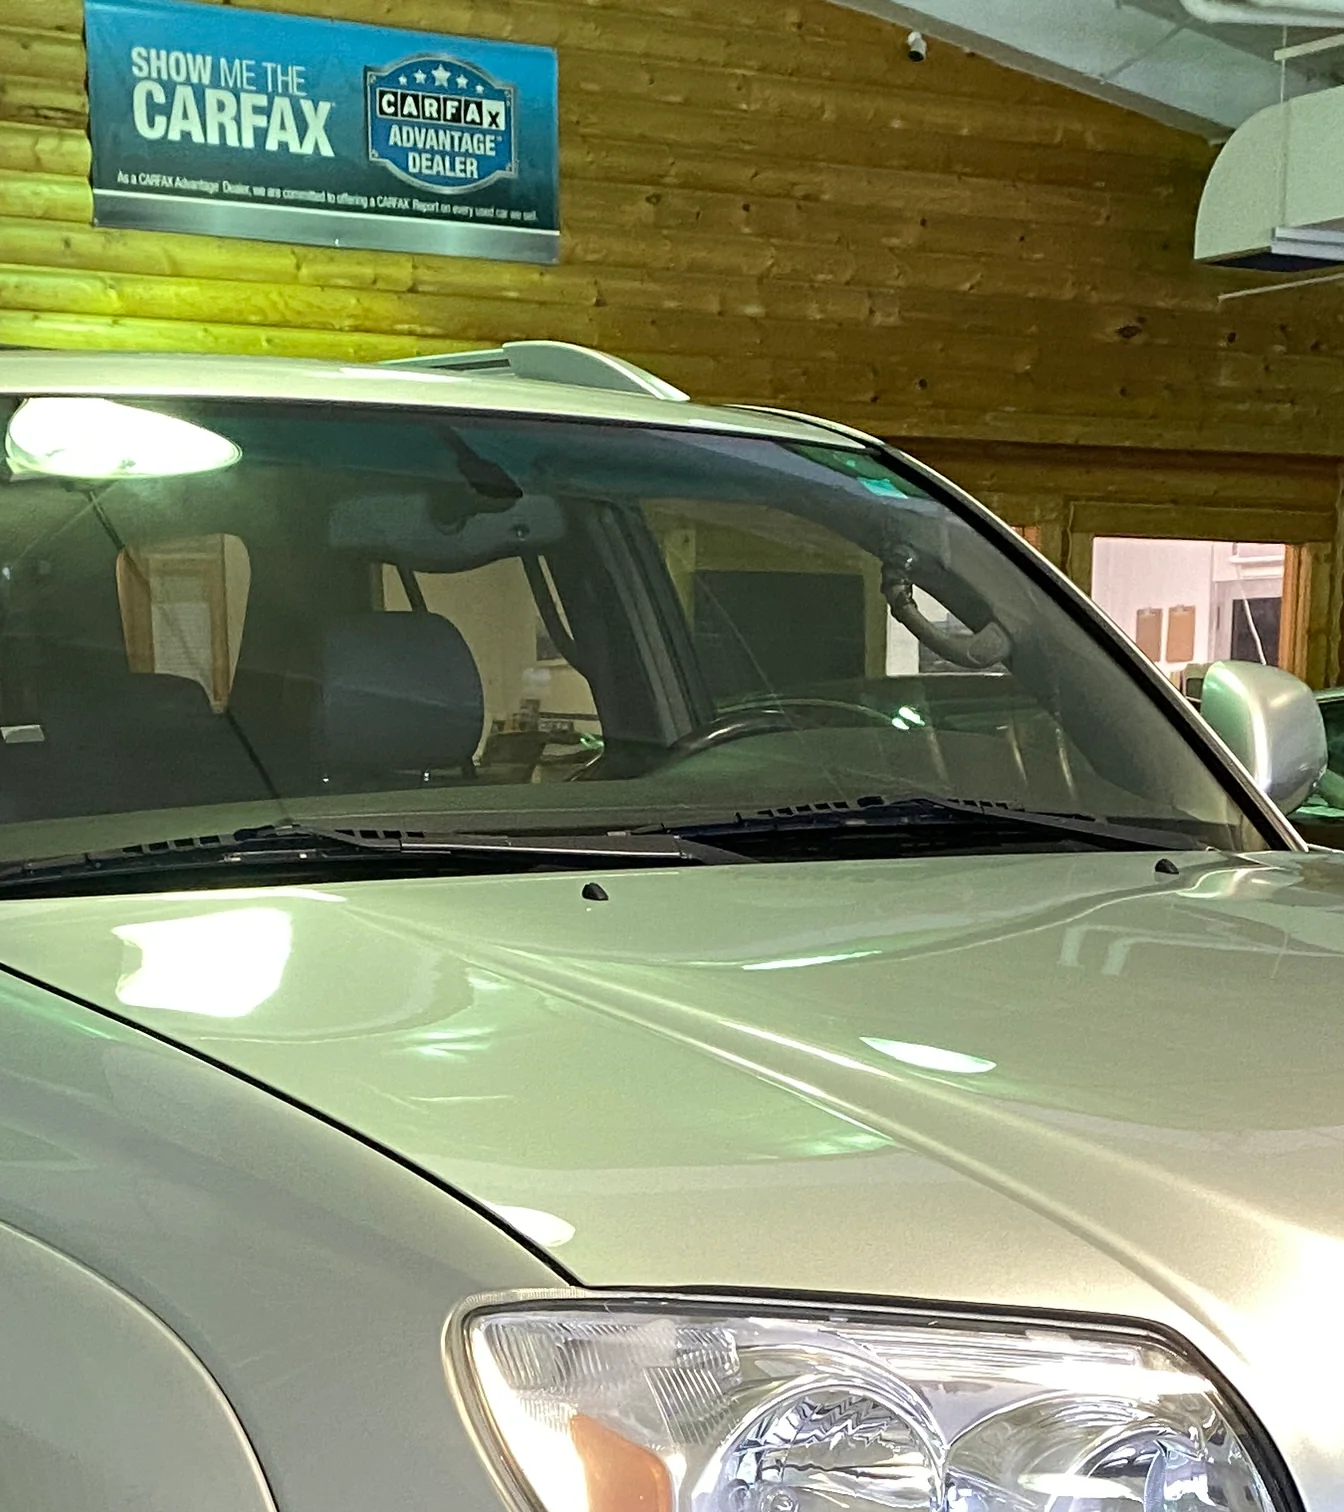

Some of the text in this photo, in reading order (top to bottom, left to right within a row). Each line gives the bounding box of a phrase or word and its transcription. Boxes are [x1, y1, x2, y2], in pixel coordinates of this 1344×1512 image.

[131, 46, 307, 96] SHOW ME THE
[133, 79, 335, 157] CARFAX
[381, 92, 500, 129] CARFAX
[388, 124, 497, 157] ADVANTAGE
[408, 151, 479, 179] DEALER
[117, 169, 130, 184] As
[138, 172, 174, 188] CARFAX
[376, 195, 409, 210] CARFAX
